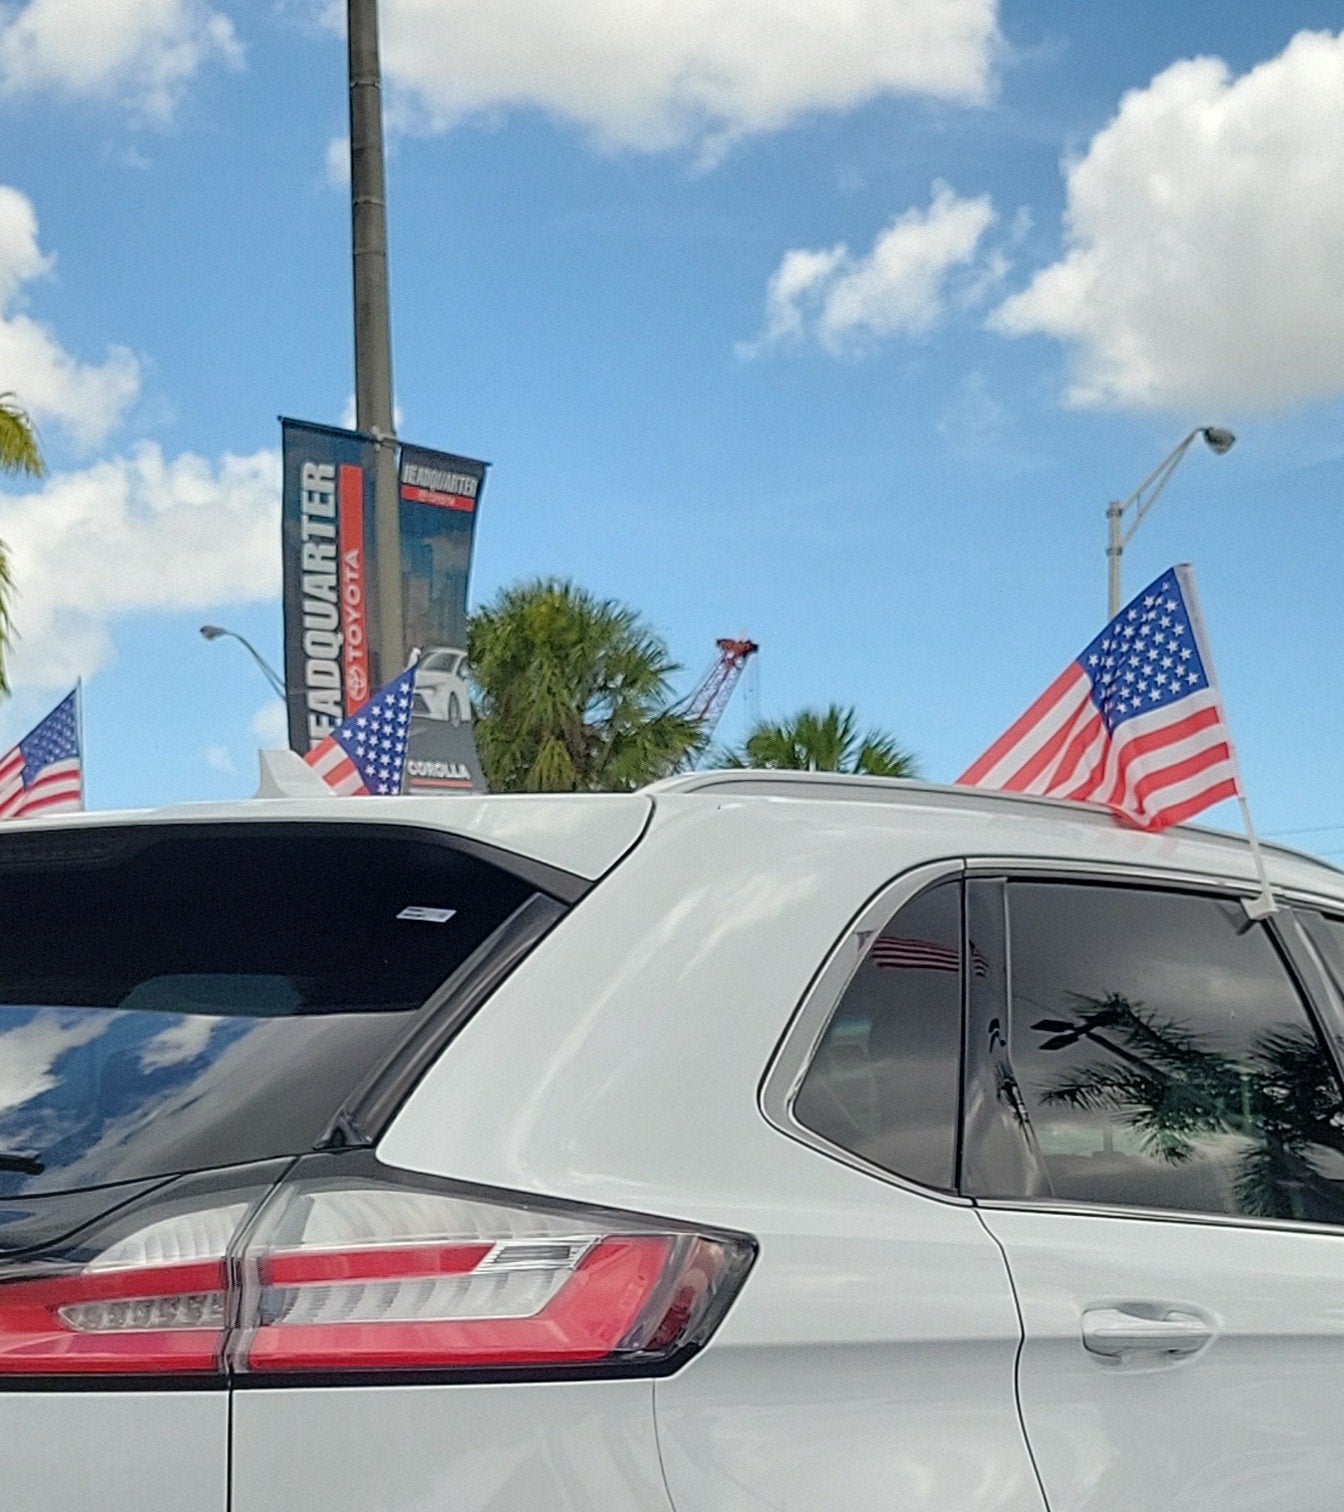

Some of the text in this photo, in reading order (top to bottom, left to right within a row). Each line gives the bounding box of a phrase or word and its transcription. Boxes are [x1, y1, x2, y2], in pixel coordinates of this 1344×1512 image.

[300, 461, 344, 749] EADQUARTER
[344, 550, 362, 660] TOYOTA
[408, 760, 471, 780] COROLLA
